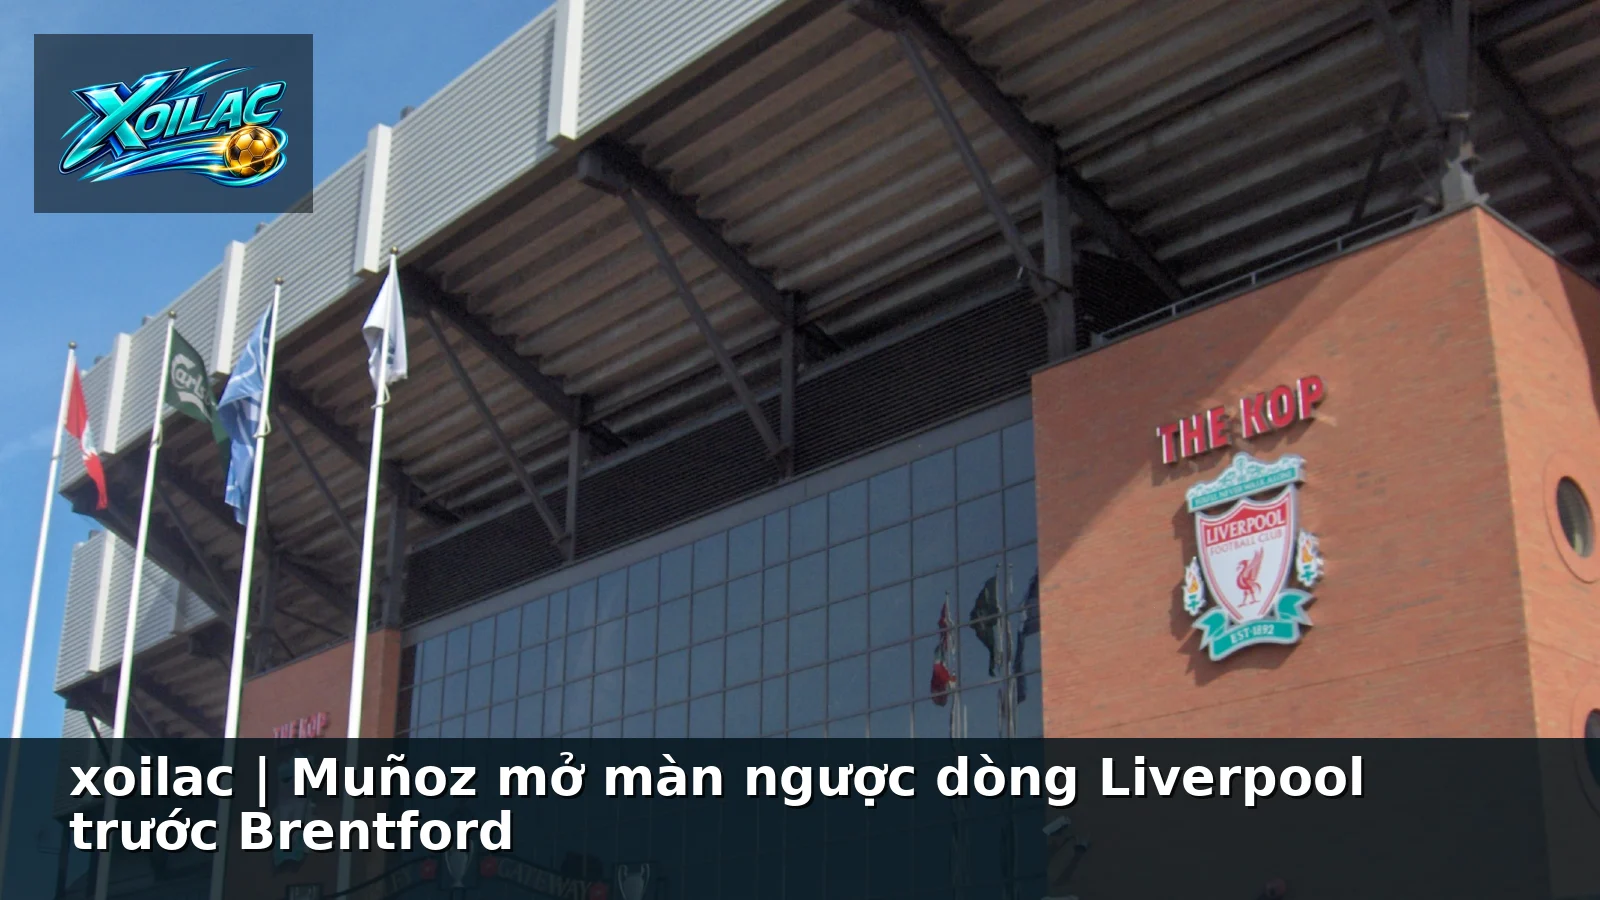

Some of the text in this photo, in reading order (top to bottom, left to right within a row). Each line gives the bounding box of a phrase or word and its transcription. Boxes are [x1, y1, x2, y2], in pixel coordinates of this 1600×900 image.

[1156, 375, 1324, 464] THE KOP
[1206, 508, 1286, 545] LIVERPOOL
[1210, 528, 1283, 556] FOOTBALL CLUB
[497, 857, 593, 899] GATEWAY
